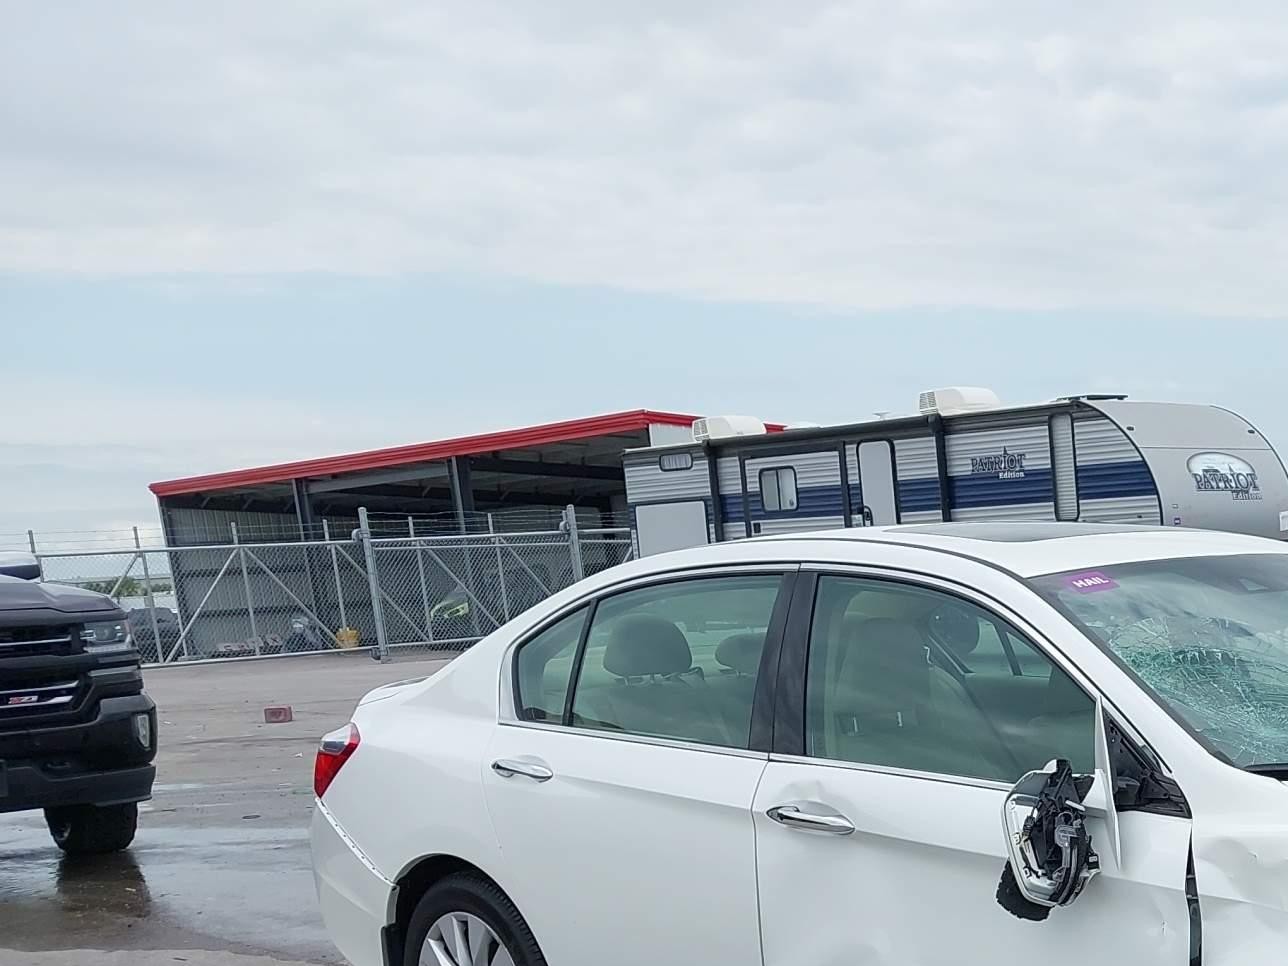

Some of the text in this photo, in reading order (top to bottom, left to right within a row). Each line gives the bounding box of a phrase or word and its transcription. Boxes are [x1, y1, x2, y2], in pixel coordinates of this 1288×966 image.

[970, 452, 1026, 473] PATRIOT
[998, 471, 1025, 479] Edition
[1191, 472, 1260, 491] PATRIOT
[1071, 576, 1110, 588] HAIL
